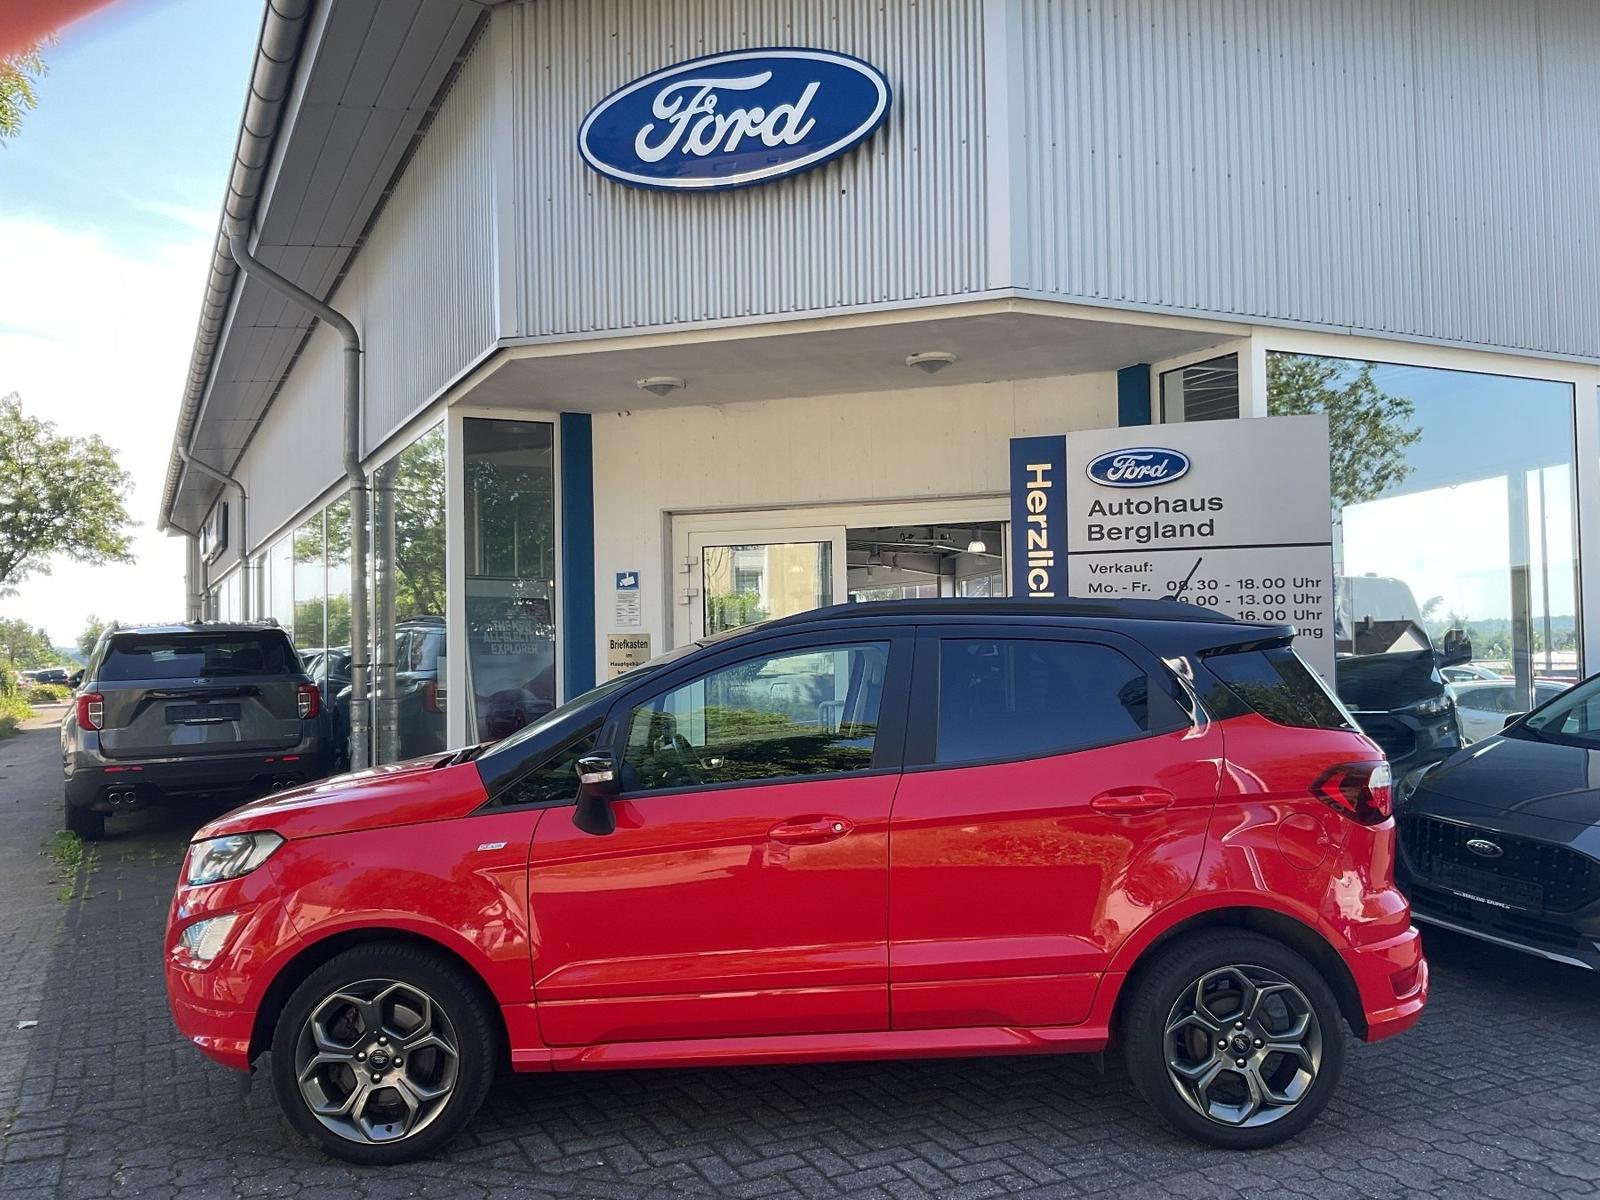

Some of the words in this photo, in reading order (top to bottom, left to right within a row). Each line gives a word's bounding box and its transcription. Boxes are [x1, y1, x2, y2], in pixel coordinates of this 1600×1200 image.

[635, 71, 821, 163] Ford
[1106, 454, 1169, 480] Ford
[1087, 496, 1224, 517] Autohaus
[1087, 518, 1215, 544] Bergland
[1088, 562, 1153, 574] Verkauf:
[1088, 583, 1118, 593] Mo.
[1131, 582, 1152, 592] Fr.
[1237, 578, 1285, 589] 18.00
[1292, 577, 1322, 588] Uhr
[1237, 594, 1286, 605] 13.00
[1293, 593, 1322, 604] Uhr
[1237, 610, 1286, 621] 16.00
[1294, 609, 1322, 620] Uhr
[610, 639, 649, 650] Briefkasten
